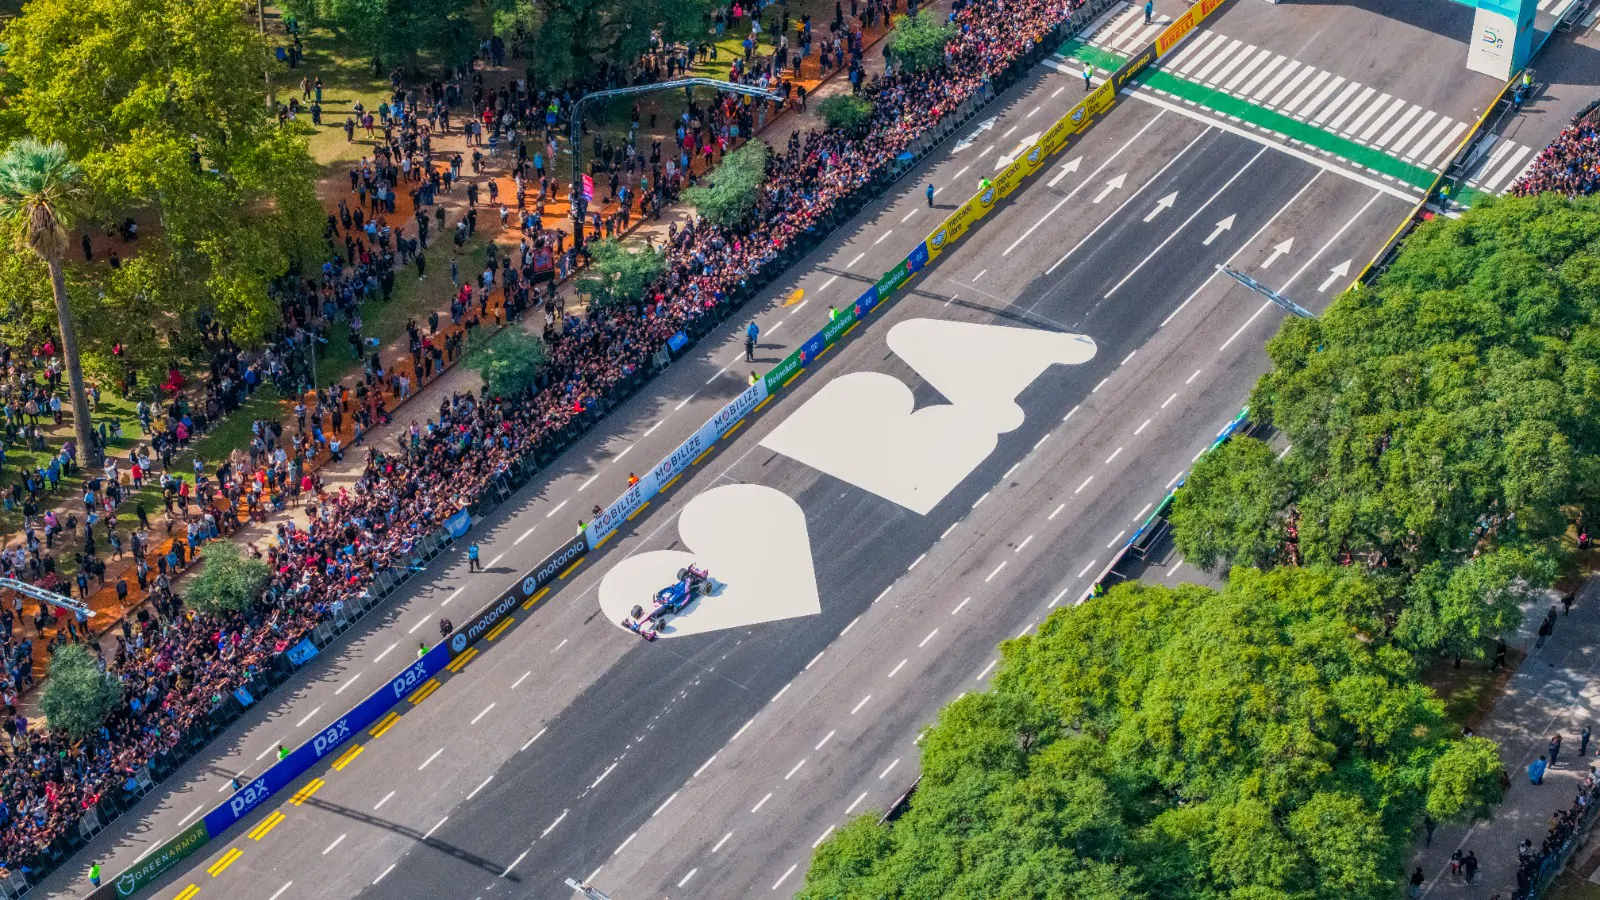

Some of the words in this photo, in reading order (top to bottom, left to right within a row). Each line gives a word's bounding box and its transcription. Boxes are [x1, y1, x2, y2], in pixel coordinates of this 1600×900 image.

[1160, 12, 1195, 52] PIRELLI
[1118, 74, 1125, 85] P
[1126, 52, 1151, 77] ZERO
[1086, 84, 1109, 107] mercado
[1042, 122, 1065, 147] mercado
[996, 163, 1021, 188] mercado
[947, 204, 973, 229] mercado
[824, 313, 853, 341] Heineken
[767, 359, 797, 387] Heineken
[714, 385, 759, 429] MOBILIZE
[655, 435, 701, 480] MOBILIZE
[594, 486, 642, 534] MOBILIZE
[537, 541, 585, 582] motorola
[468, 595, 516, 639] motorola
[392, 661, 426, 699] pax
[313, 718, 350, 757] pax
[230, 778, 268, 818] pax
[135, 828, 204, 880] GREENARMOR
